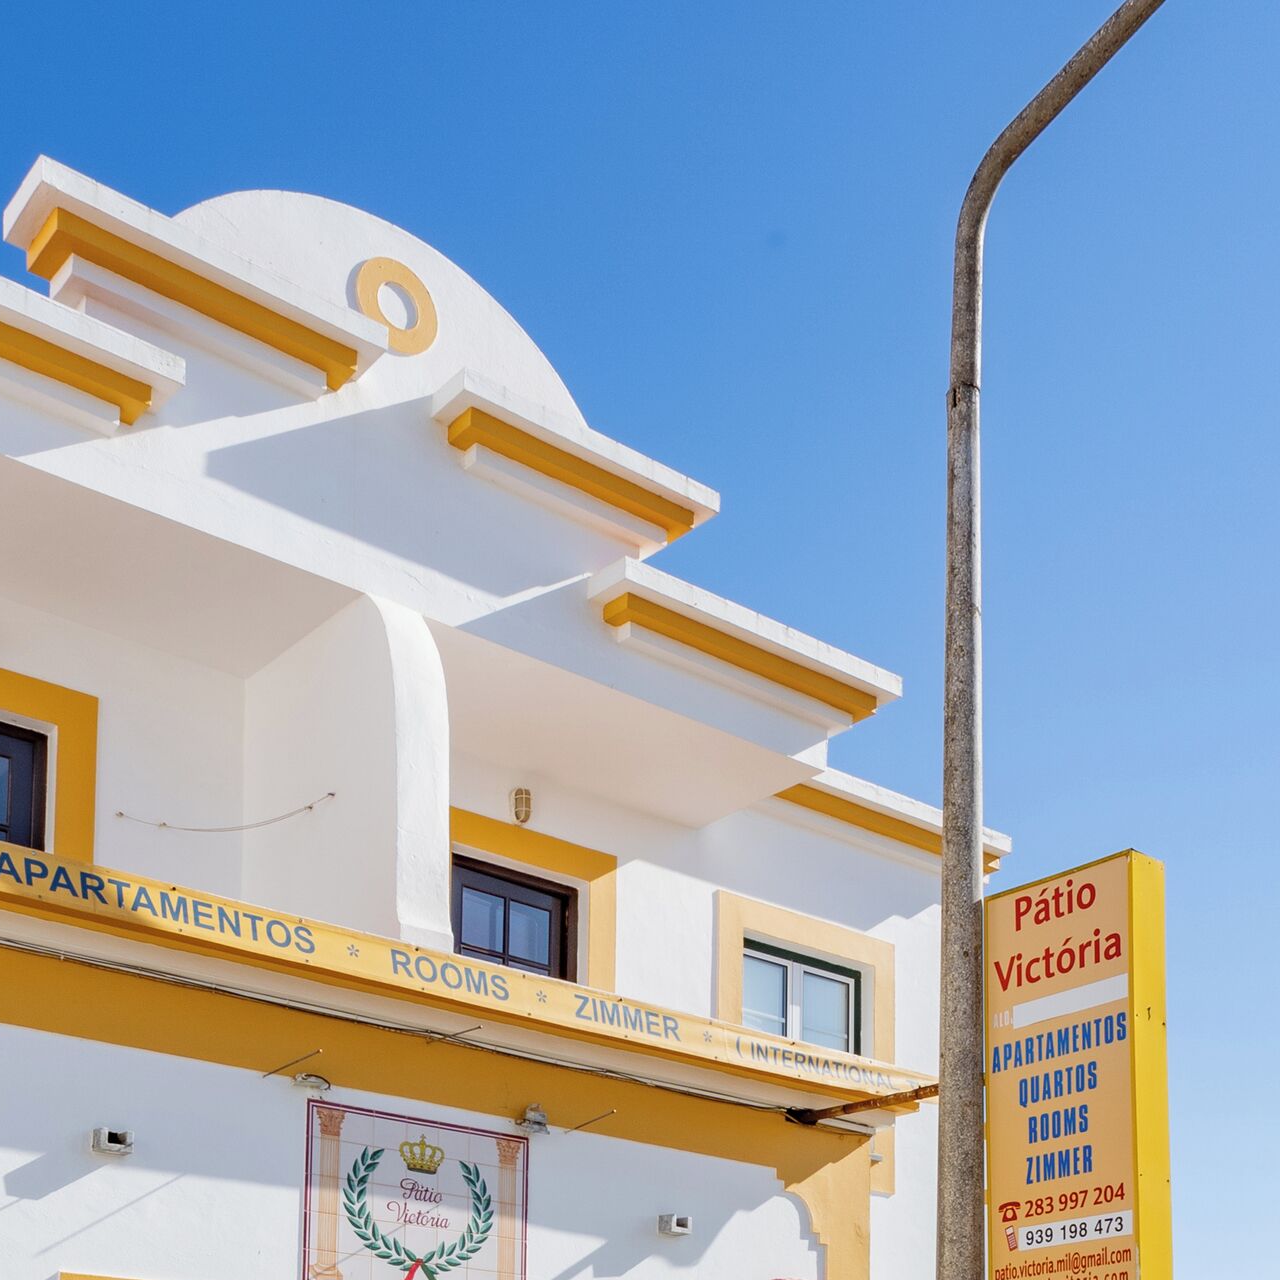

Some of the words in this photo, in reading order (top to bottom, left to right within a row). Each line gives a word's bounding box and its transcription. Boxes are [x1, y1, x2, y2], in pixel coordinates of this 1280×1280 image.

[1015, 879, 1096, 932] Pátio
[994, 928, 1122, 992] Victória
[390, 948, 510, 1001] ROOMS
[573, 993, 681, 1042] ZIMMER
[992, 1012, 1127, 1074] APARTAMENTOS
[1019, 1060, 1097, 1108] QUARTOS
[1028, 1104, 1089, 1144] ROOMS
[1026, 1144, 1093, 1185] ZIMMER
[400, 1178, 442, 1204] Pátio
[1024, 1196, 1054, 1218] 283
[1059, 1190, 1088, 1212] 997
[1093, 1182, 1125, 1206] 204
[387, 1201, 450, 1229] Victória
[1025, 1227, 1054, 1246] 939
[1060, 1222, 1087, 1240] 198
[1094, 1216, 1124, 1235] 473
